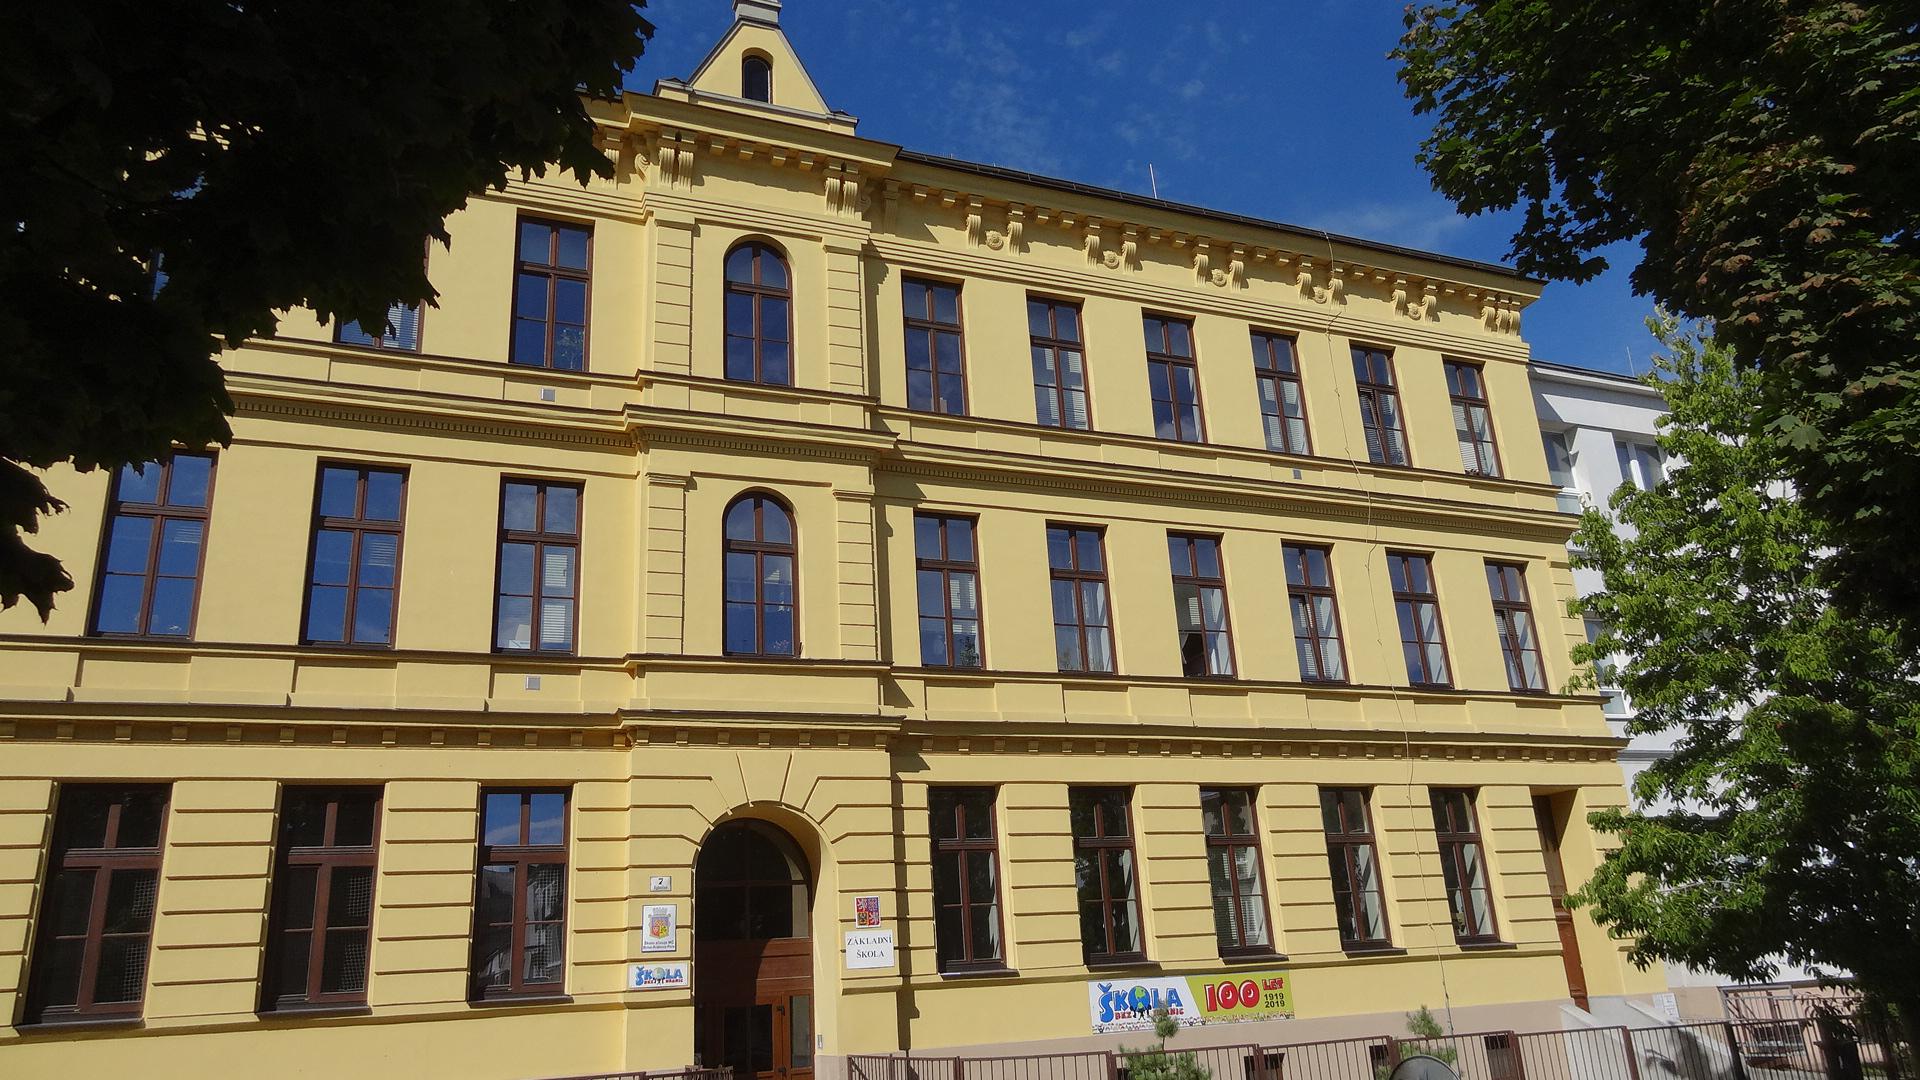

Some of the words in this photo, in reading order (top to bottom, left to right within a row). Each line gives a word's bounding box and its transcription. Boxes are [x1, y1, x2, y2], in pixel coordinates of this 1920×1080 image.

[847, 934, 892, 946] ZÁKLADNÍ
[856, 949, 885, 959] ŠKOLA
[635, 966, 683, 986] ŠKOLA
[1261, 977, 1284, 990] LET
[1204, 979, 1260, 1012] 100
[1264, 992, 1284, 1000] 1919
[1097, 982, 1183, 1023] ŠKOLA
[1264, 1000, 1285, 1008] 2019
[1115, 1011, 1132, 1020] BEZ
